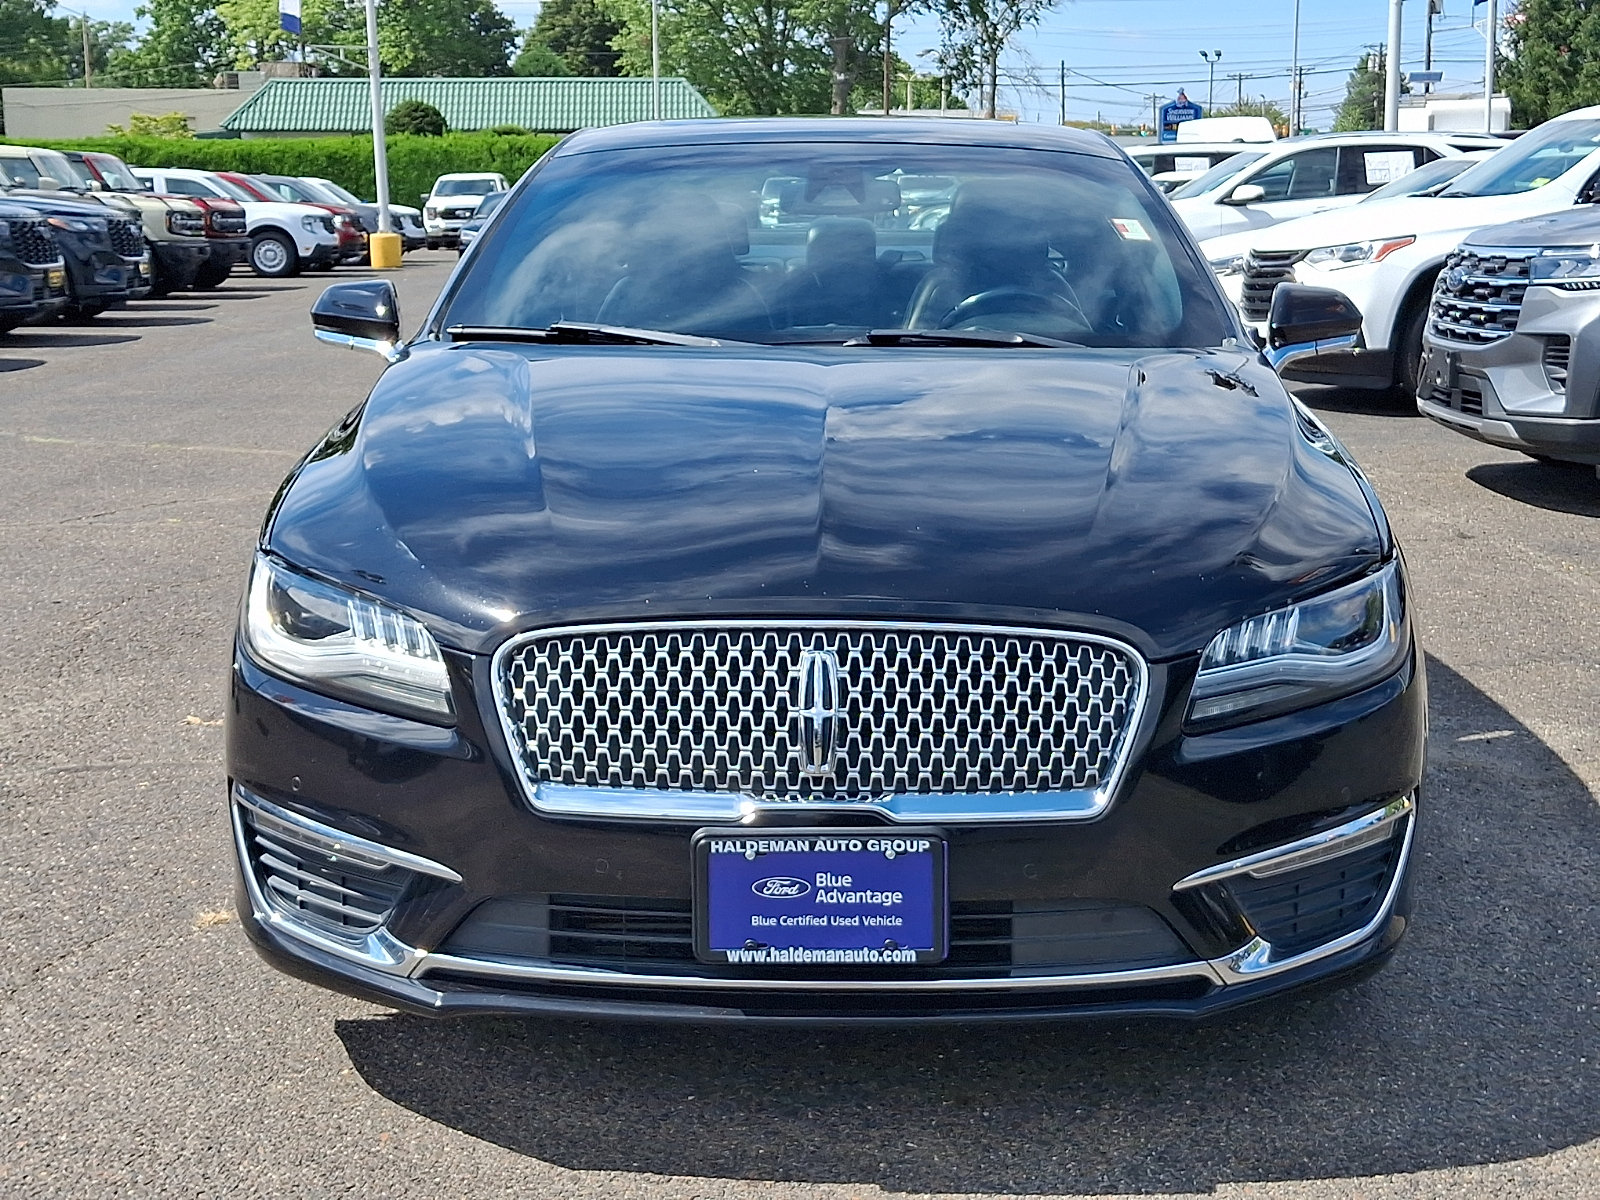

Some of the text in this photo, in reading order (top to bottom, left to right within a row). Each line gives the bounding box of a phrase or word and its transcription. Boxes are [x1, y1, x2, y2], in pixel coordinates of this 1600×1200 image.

[710, 839, 930, 853] HALDEMAN AUTO GROUP
[761, 878, 801, 896] Ford
[815, 872, 852, 887] Blue
[815, 889, 903, 906] Advantage
[751, 915, 903, 926] Blue Certified Used Vehicle
[726, 947, 917, 963] www.haldemanauto.com
